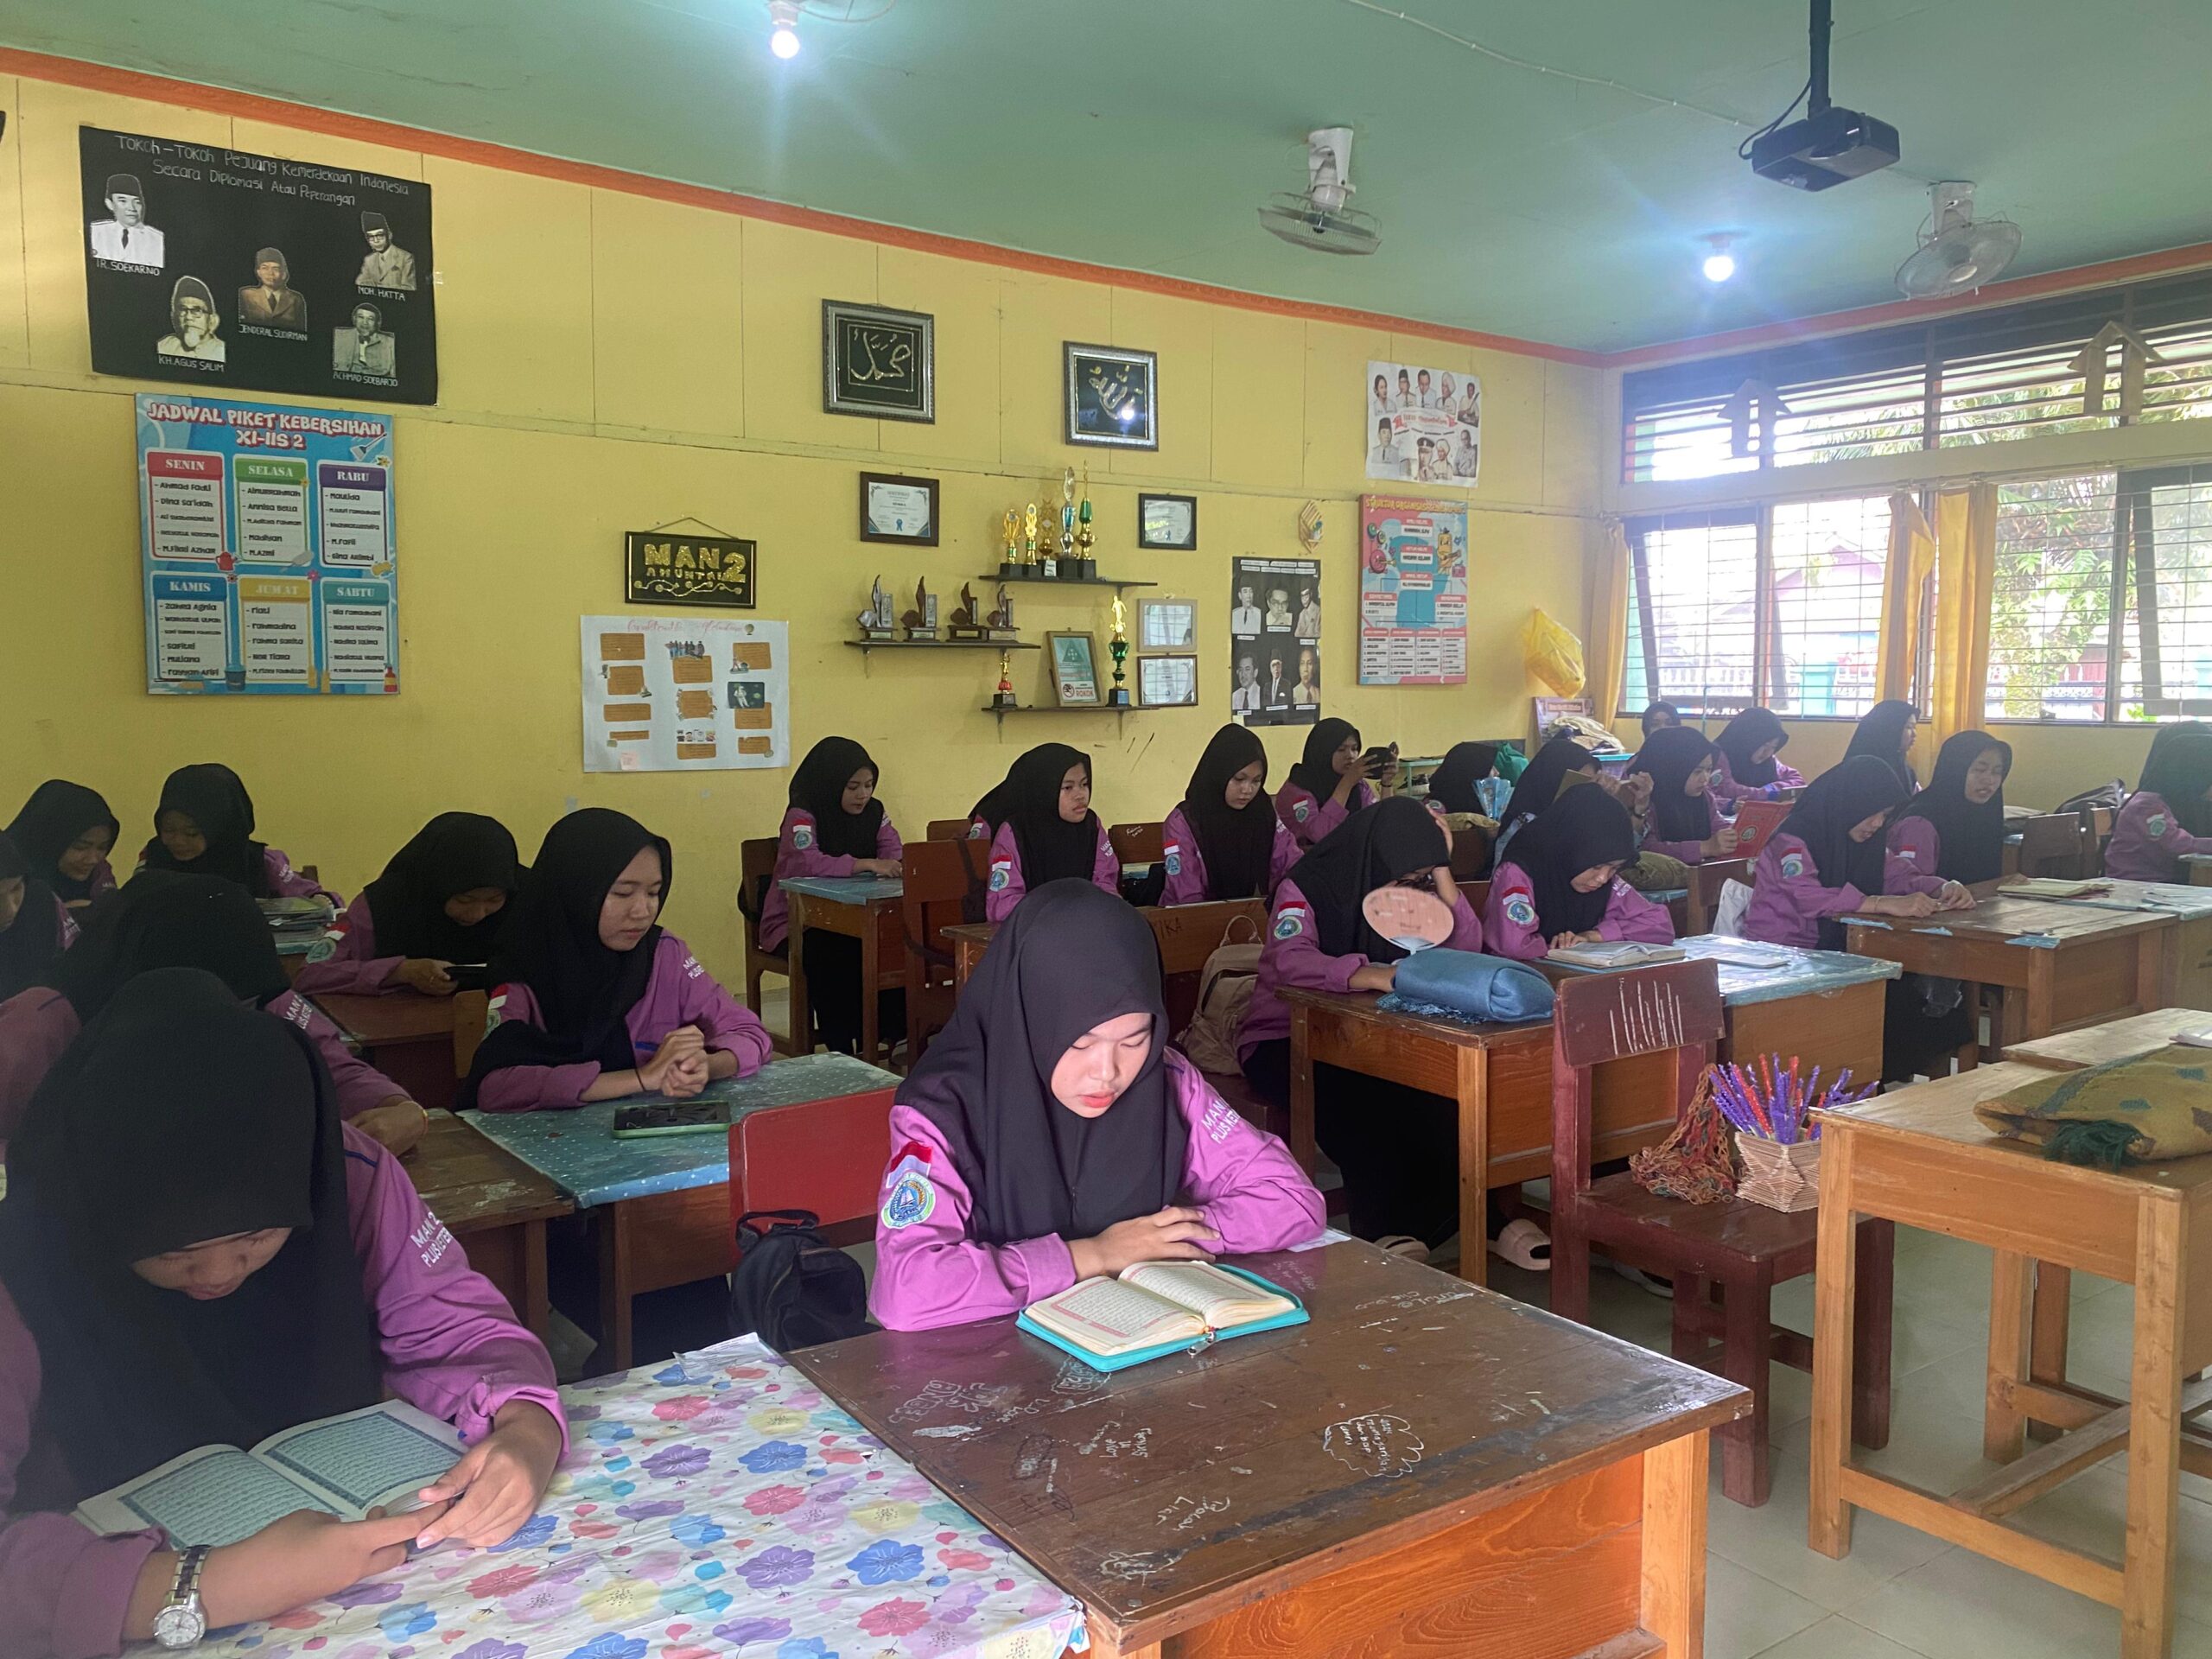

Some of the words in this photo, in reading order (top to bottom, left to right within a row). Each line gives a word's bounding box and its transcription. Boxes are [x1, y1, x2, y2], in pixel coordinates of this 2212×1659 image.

[111, 261, 160, 276] SOEKARNO
[378, 289, 405, 301] HATTA
[200, 360, 225, 372] SALIM
[147, 403, 226, 424] JADWAL
[227, 410, 277, 428] PIKET
[278, 414, 385, 436] KEBERSIHAN
[236, 430, 289, 448] XI-IIS
[293, 435, 307, 449] 2
[165, 459, 205, 471] SENIN
[248, 465, 294, 478] SELASA
[337, 471, 370, 483] RABU
[644, 543, 720, 569] MAN
[721, 552, 747, 583] 2
[169, 581, 212, 593] KAMIS
[337, 587, 375, 598] SABTU
[1201, 1100, 1227, 1130] MAN
[410, 1217, 436, 1248] MAN
